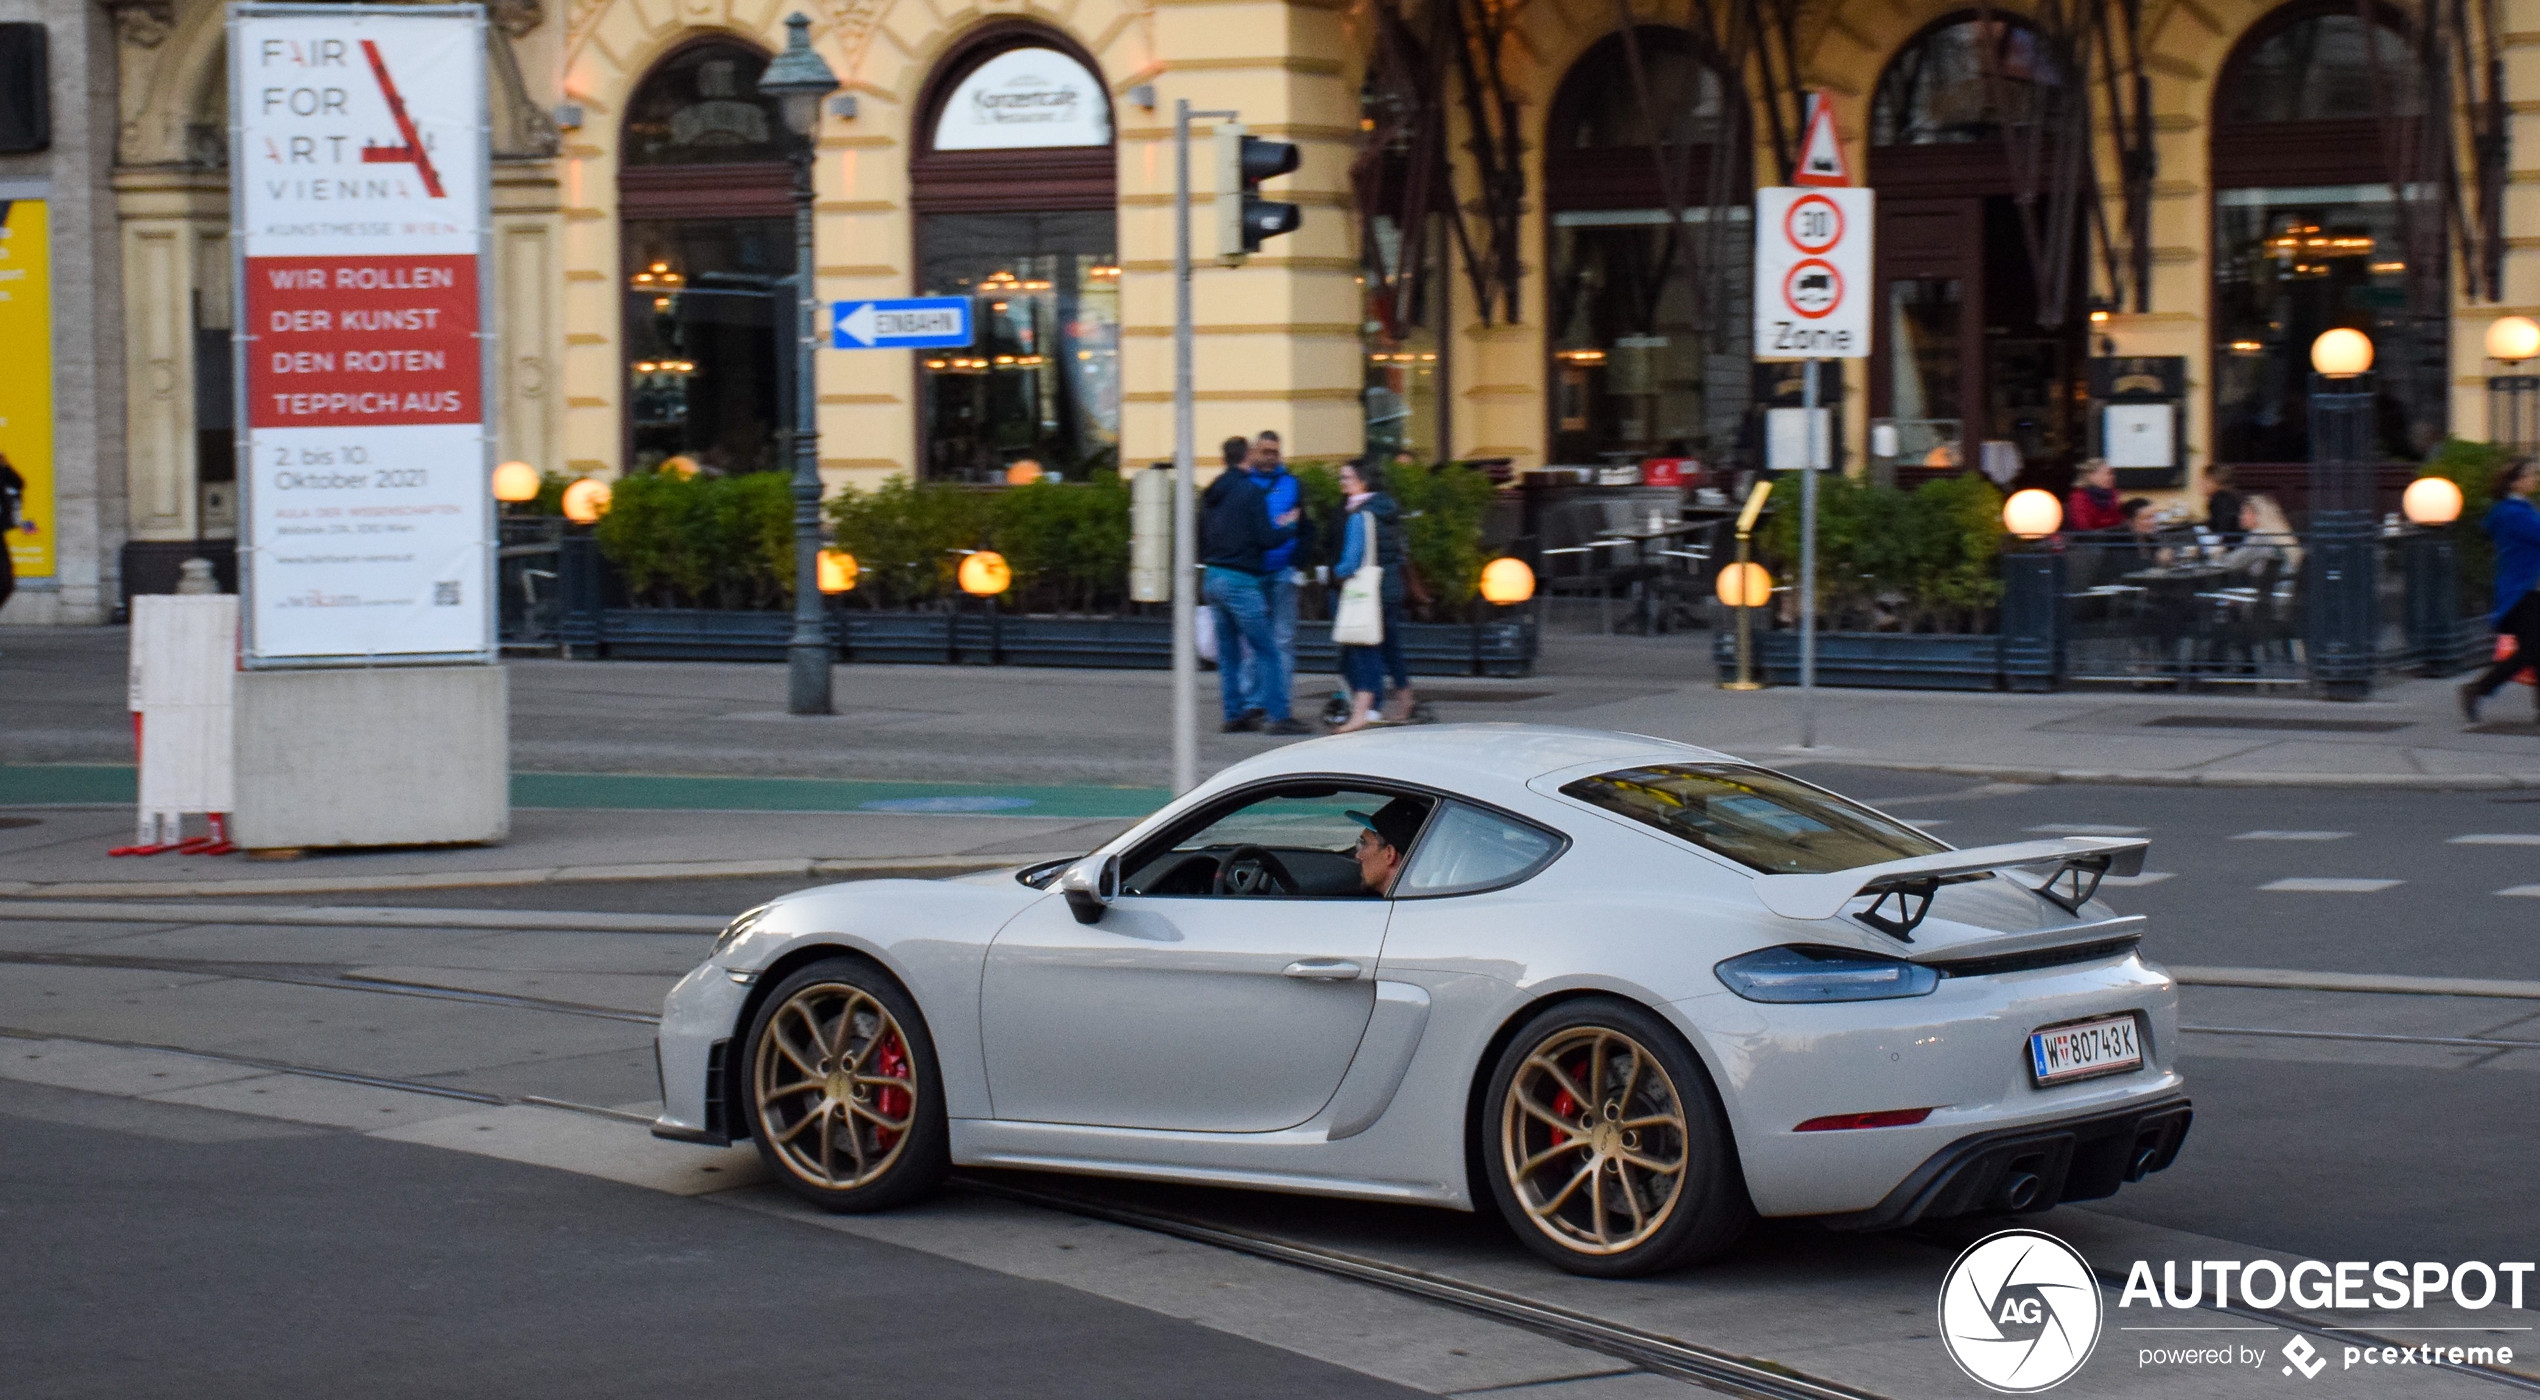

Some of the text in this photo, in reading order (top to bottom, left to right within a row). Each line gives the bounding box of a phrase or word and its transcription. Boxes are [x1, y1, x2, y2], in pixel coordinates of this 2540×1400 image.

[262, 39, 347, 67] FAIR
[262, 87, 348, 117] FOR
[264, 135, 348, 164] ART
[266, 179, 411, 200] VIENNA
[267, 221, 393, 237] KUNSTMESSE
[1801, 211, 1828, 237] 30
[269, 266, 454, 290] WIR ROLLEN
[270, 308, 440, 332] DER KUNST
[876, 312, 954, 334] EINBAHN
[1773, 321, 1851, 350] Zone
[271, 350, 445, 374] DEN ROTEN
[272, 390, 463, 415] TEPPICH AUS
[302, 446, 335, 465] bis
[274, 468, 429, 490] Oktober 2021
